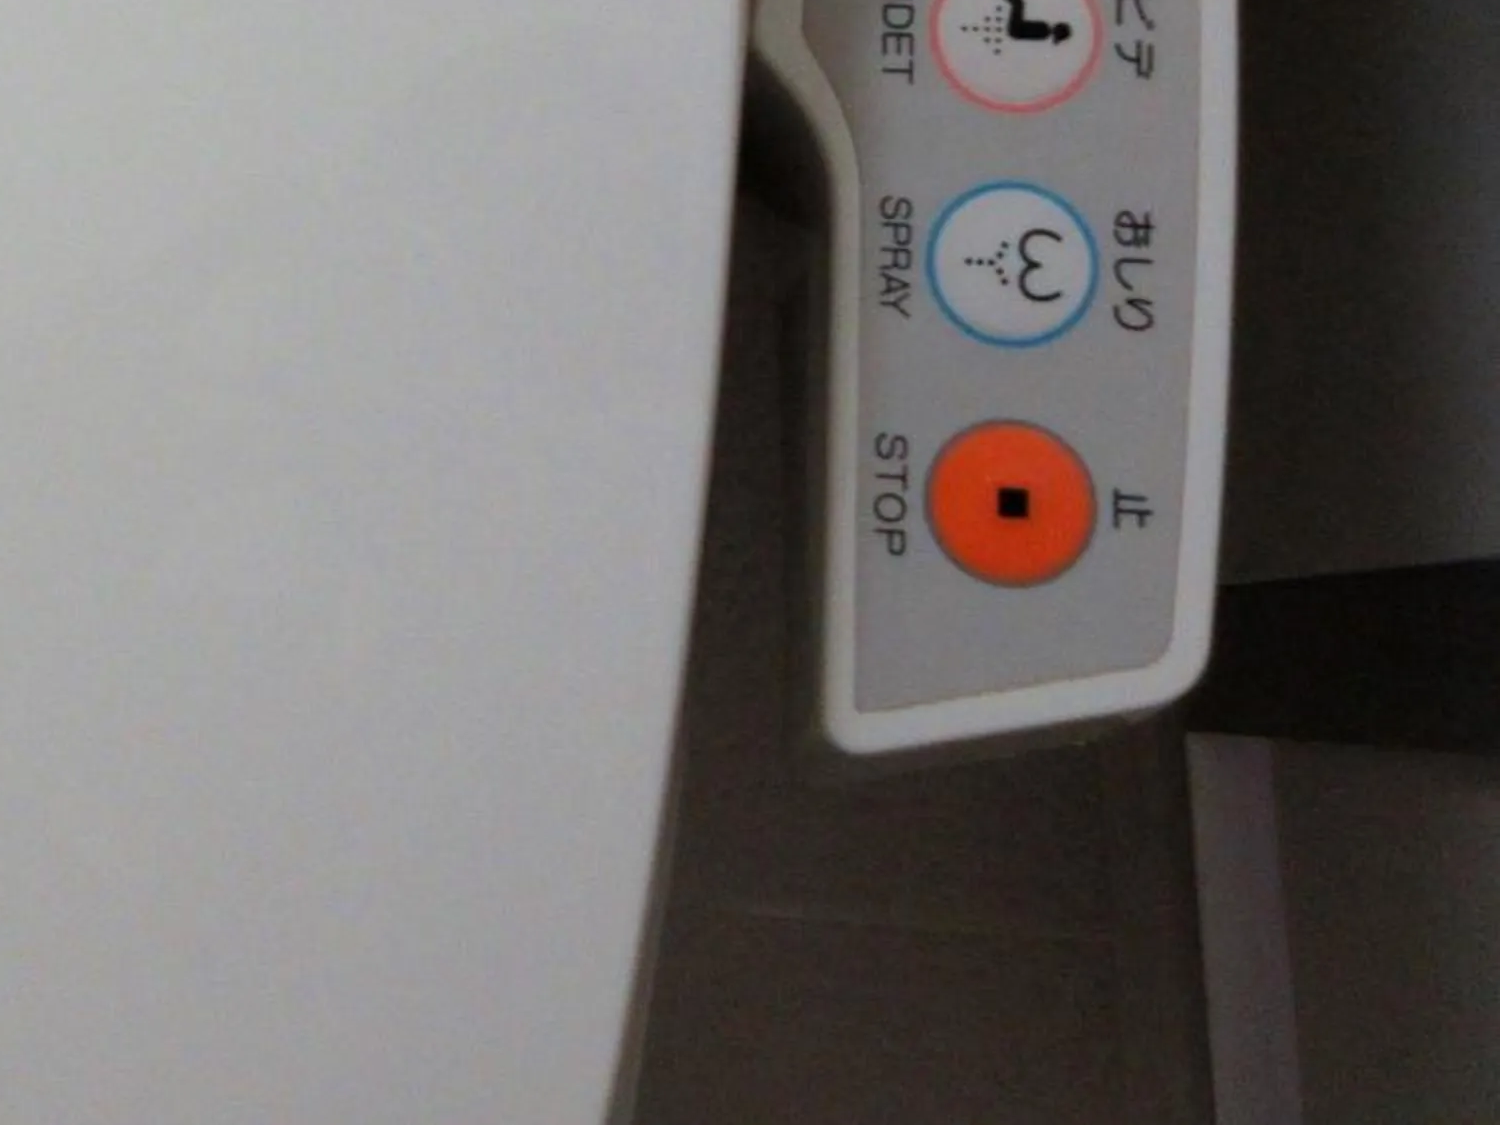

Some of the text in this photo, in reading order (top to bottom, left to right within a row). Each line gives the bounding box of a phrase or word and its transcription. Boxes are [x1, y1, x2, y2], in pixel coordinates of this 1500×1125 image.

[879, 194, 913, 320] SPRAY
[1112, 209, 1156, 333] おしり
[872, 431, 910, 558] STOP
[1111, 487, 1155, 530] 止
